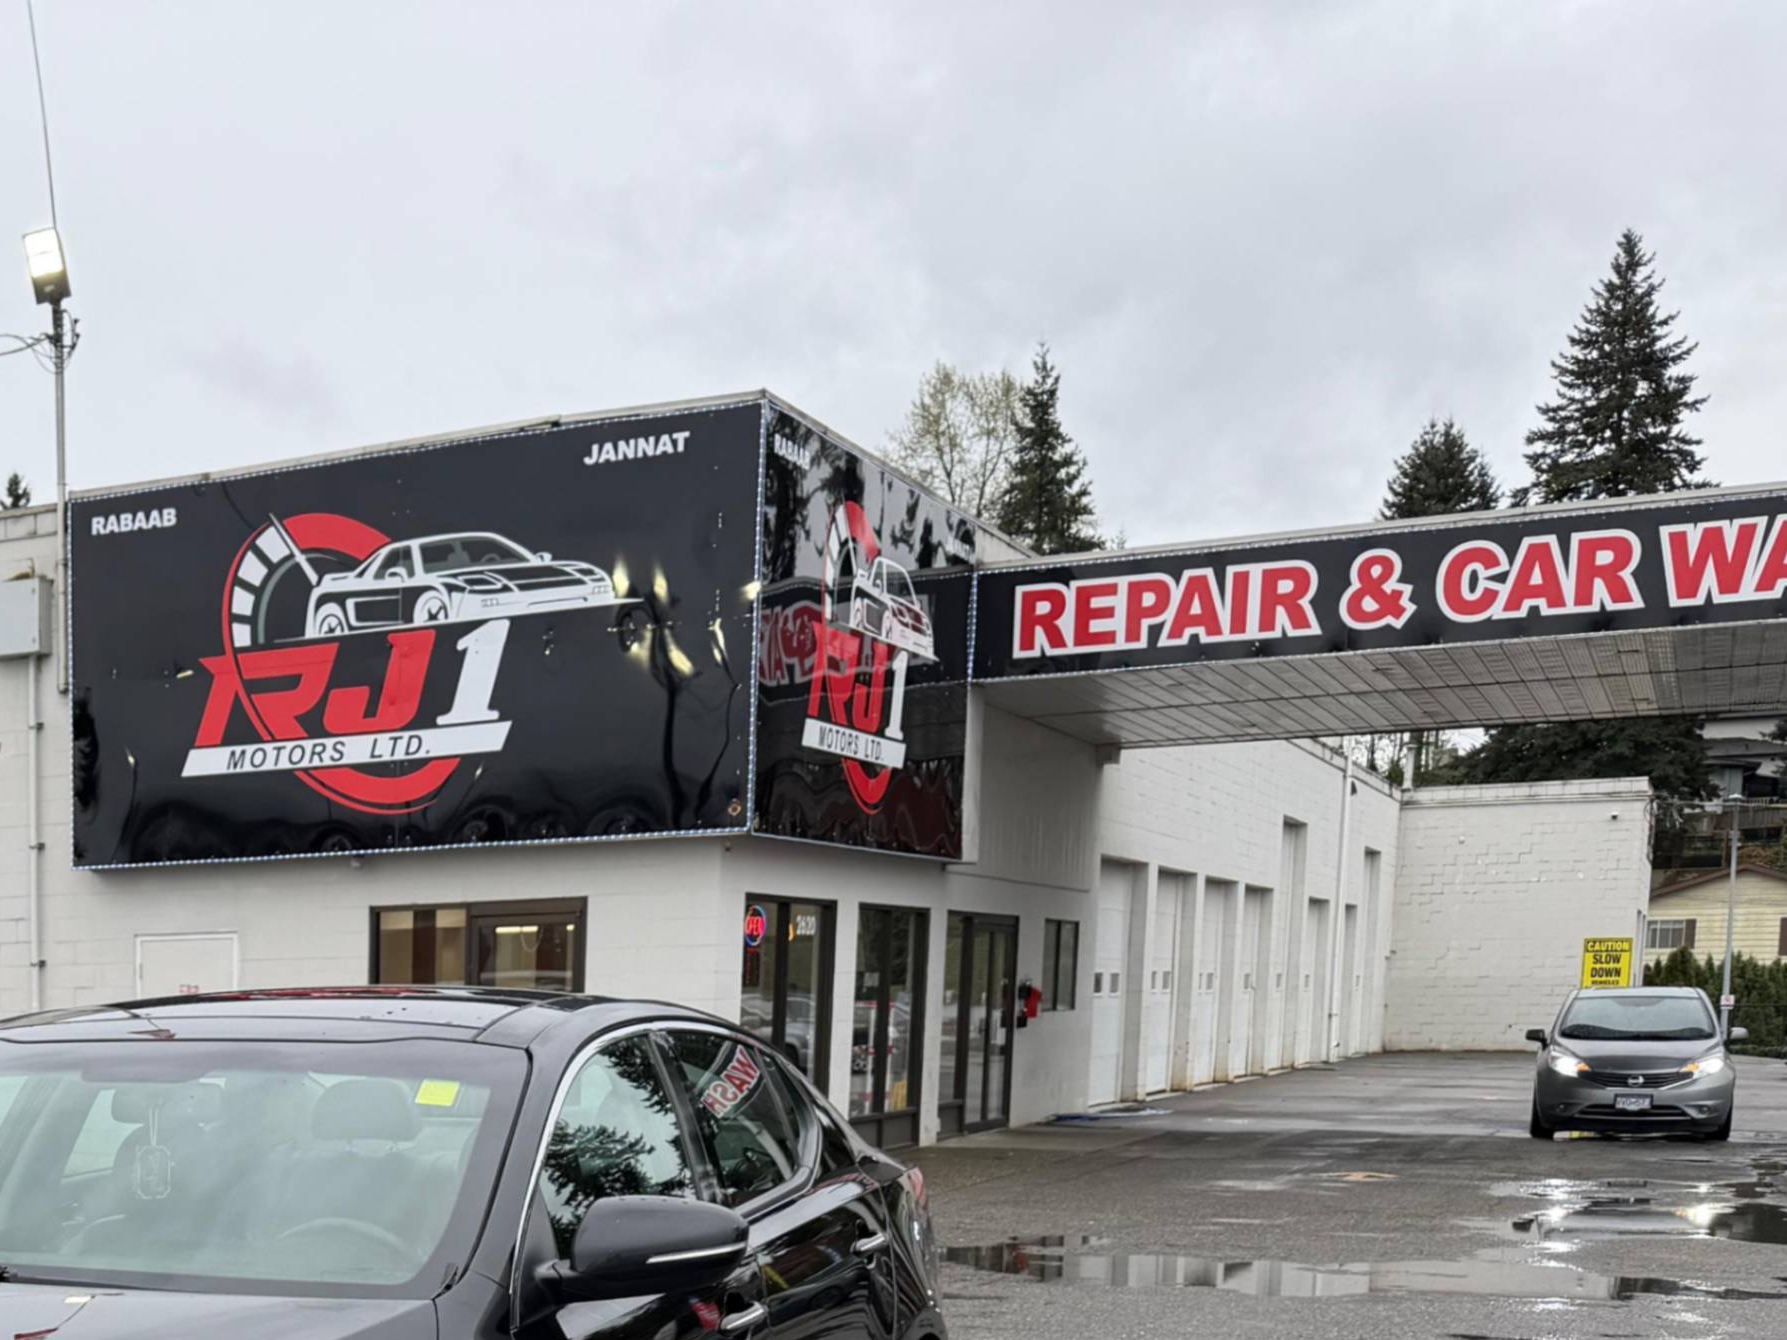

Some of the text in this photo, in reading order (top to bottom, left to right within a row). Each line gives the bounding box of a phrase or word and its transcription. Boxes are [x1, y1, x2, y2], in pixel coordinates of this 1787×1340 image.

[583, 431, 691, 466] JANNAT
[90, 507, 178, 537] RABAAB
[1013, 559, 1322, 659] REPAIR
[1339, 547, 1416, 630] &
[1435, 528, 1645, 624] CAR
[196, 618, 511, 749] RJ1
[806, 617, 908, 741] RJ1
[225, 729, 432, 774] MOTORS LTD.
[819, 724, 885, 762] MOTORS LTD.
[1587, 941, 1630, 951] CAUTION
[1592, 953, 1622, 965] SLOW
[1590, 967, 1622, 978] DOWN
